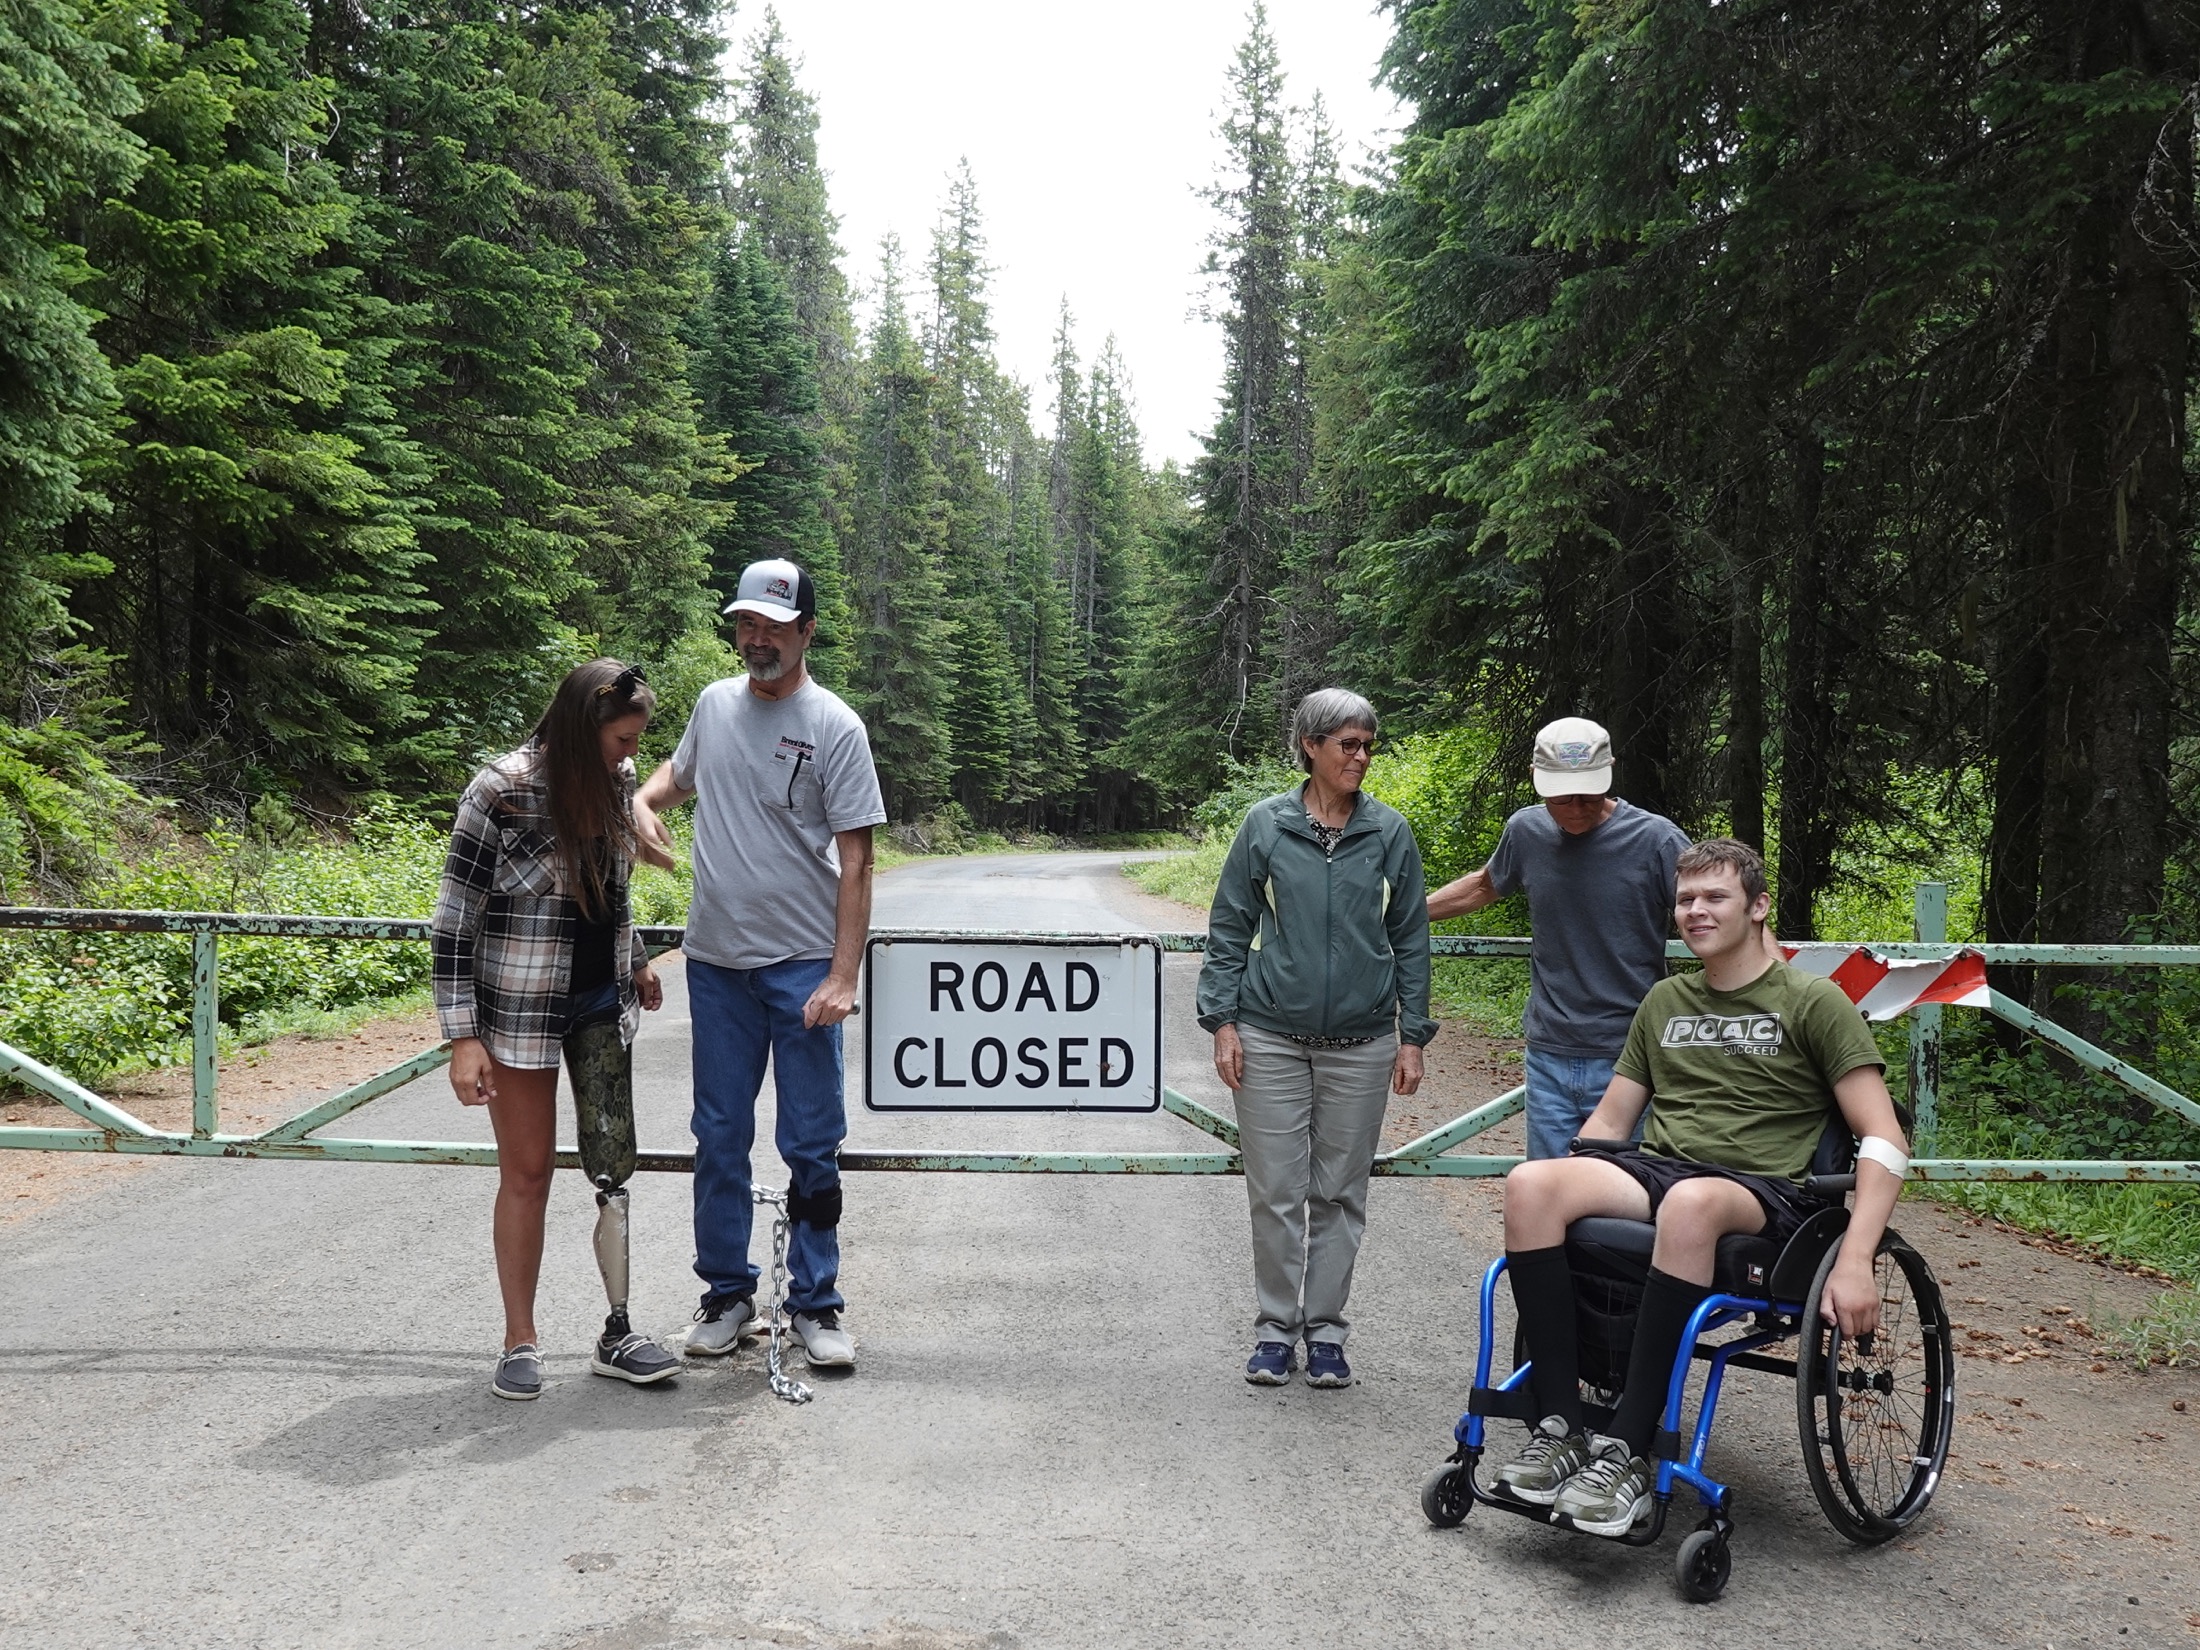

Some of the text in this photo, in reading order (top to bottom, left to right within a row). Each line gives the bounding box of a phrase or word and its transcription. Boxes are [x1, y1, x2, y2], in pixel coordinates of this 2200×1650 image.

[930, 961, 1100, 1012] ROAD
[1671, 1019, 1775, 1041] POAC
[893, 1036, 1134, 1089] CLOSED
[1723, 1045, 1779, 1056] SUCCEED
